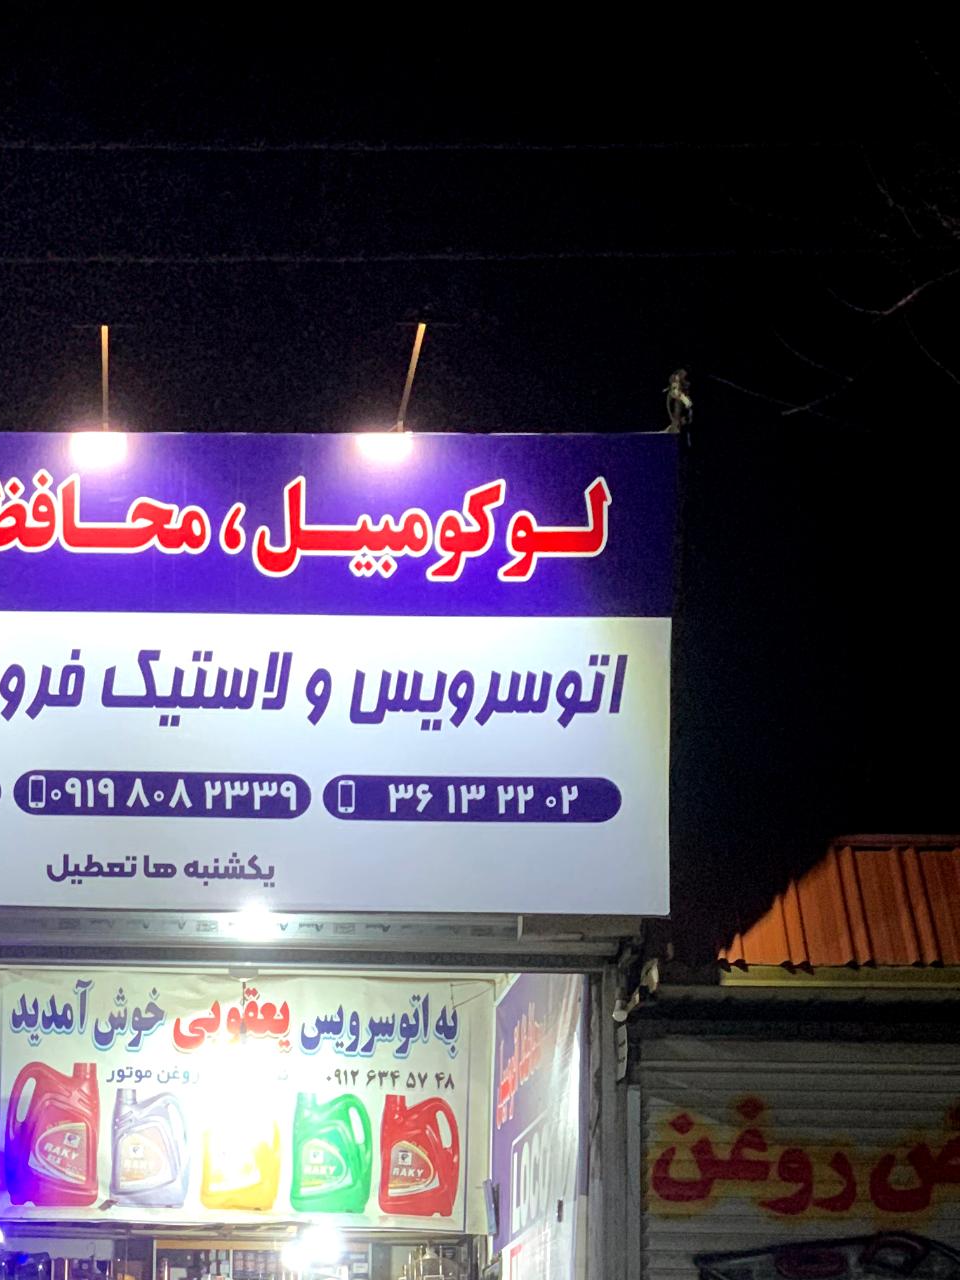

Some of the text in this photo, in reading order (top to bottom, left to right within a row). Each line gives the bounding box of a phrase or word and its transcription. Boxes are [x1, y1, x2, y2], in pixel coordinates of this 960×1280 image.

[101, 650, 294, 728] لاستیک
[305, 667, 332, 726] و
[349, 653, 629, 732] اتوسرویس
[46, 853, 138, 885] تعطیل
[183, 851, 276, 888] یکشنبه
[9, 979, 460, 1058] به اتوسرویس یعقوبی خوش آمدید
[105, 1065, 153, 1083] موتور
[651, 1096, 858, 1214] روغن
